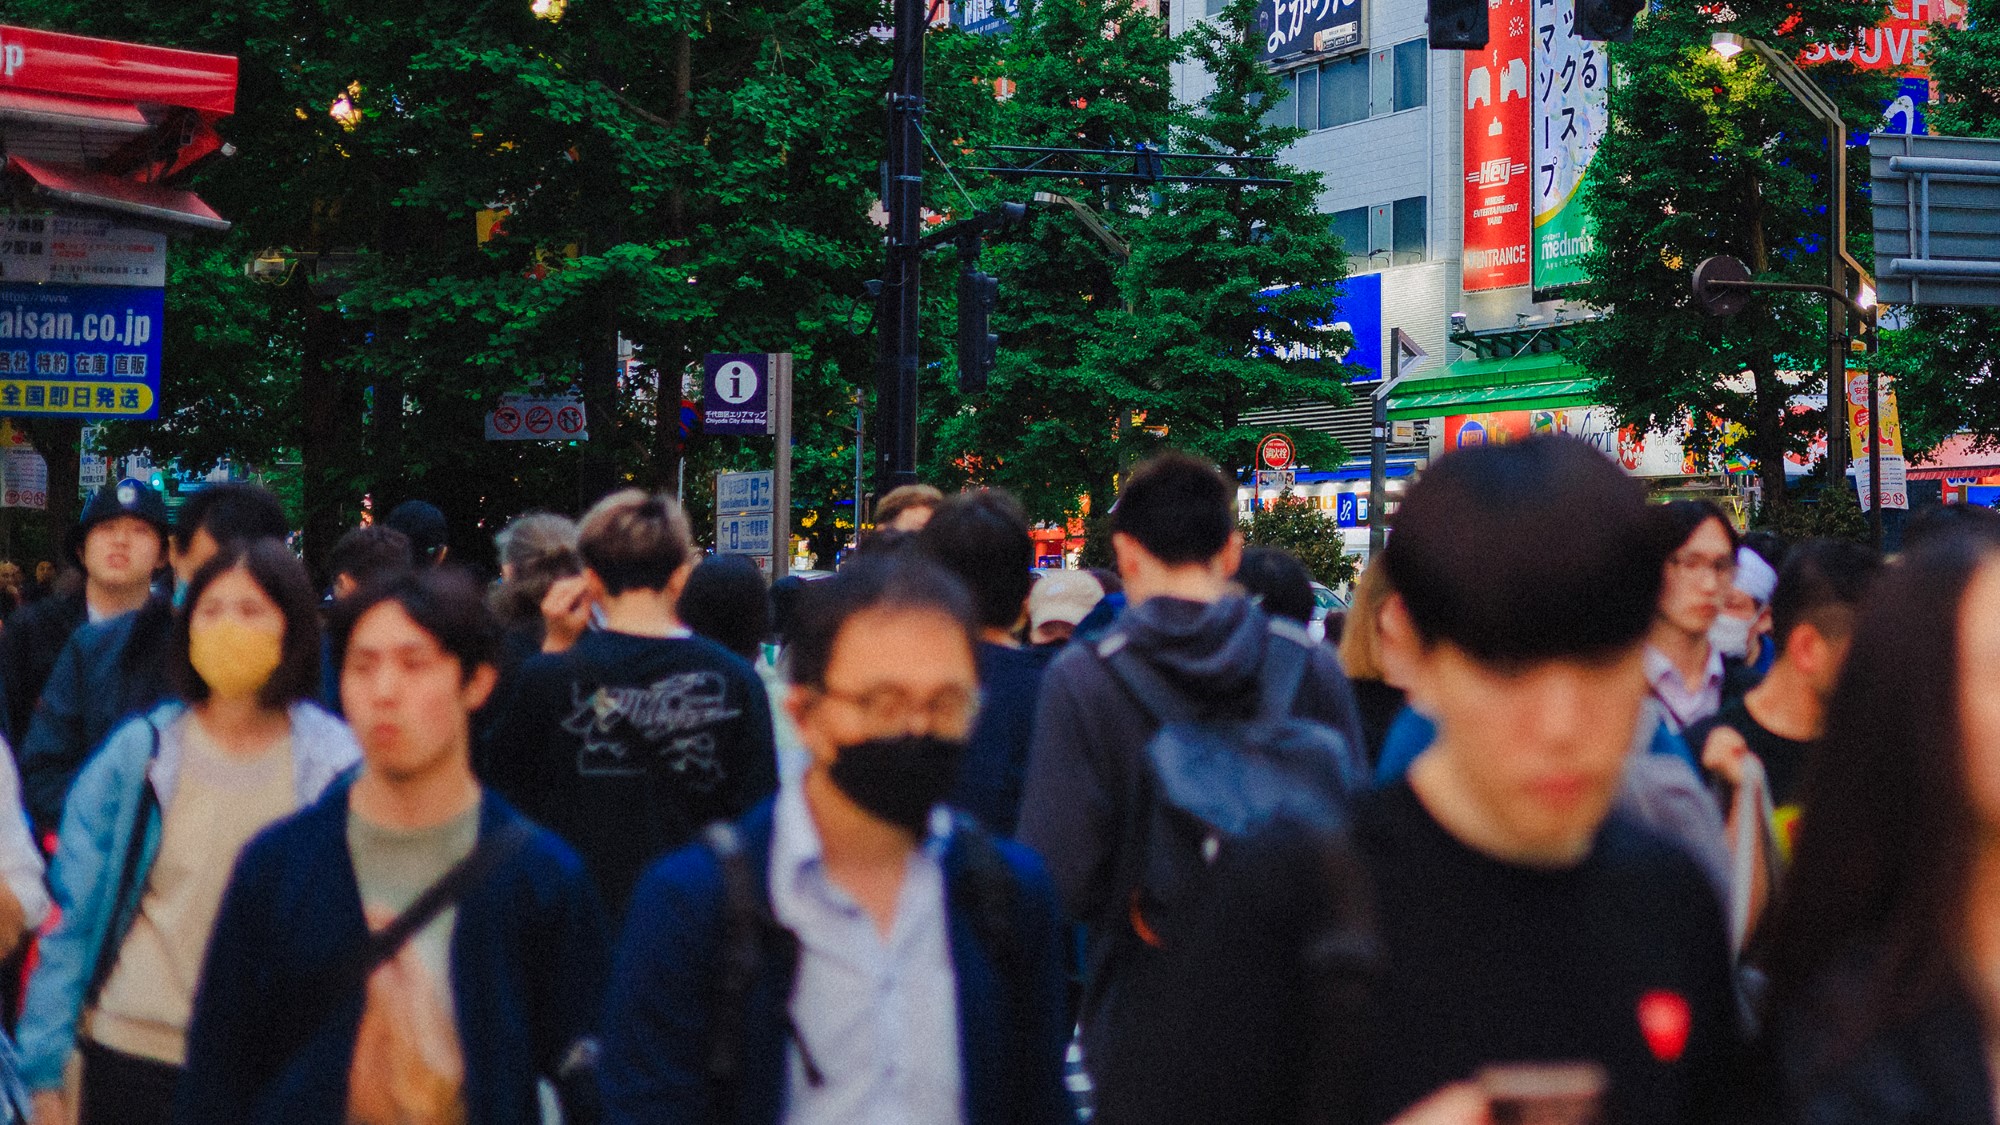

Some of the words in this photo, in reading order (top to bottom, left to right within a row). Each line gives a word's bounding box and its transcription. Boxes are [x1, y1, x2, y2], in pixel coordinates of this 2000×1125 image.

[1478, 157, 1512, 189] Hey
[1473, 202, 1519, 218] ENTERTAINMENT
[1541, 227, 1595, 260] medimix
[0, 305, 150, 346] aisan.co.jp
[35, 352, 69, 374] 特約
[75, 354, 108, 375] 在庫
[113, 355, 147, 377] 直販
[2, 384, 140, 409] 全国即日発送
[705, 410, 767, 418] 千代田区エリアマップ
[1265, 447, 1288, 459] 消火栓
